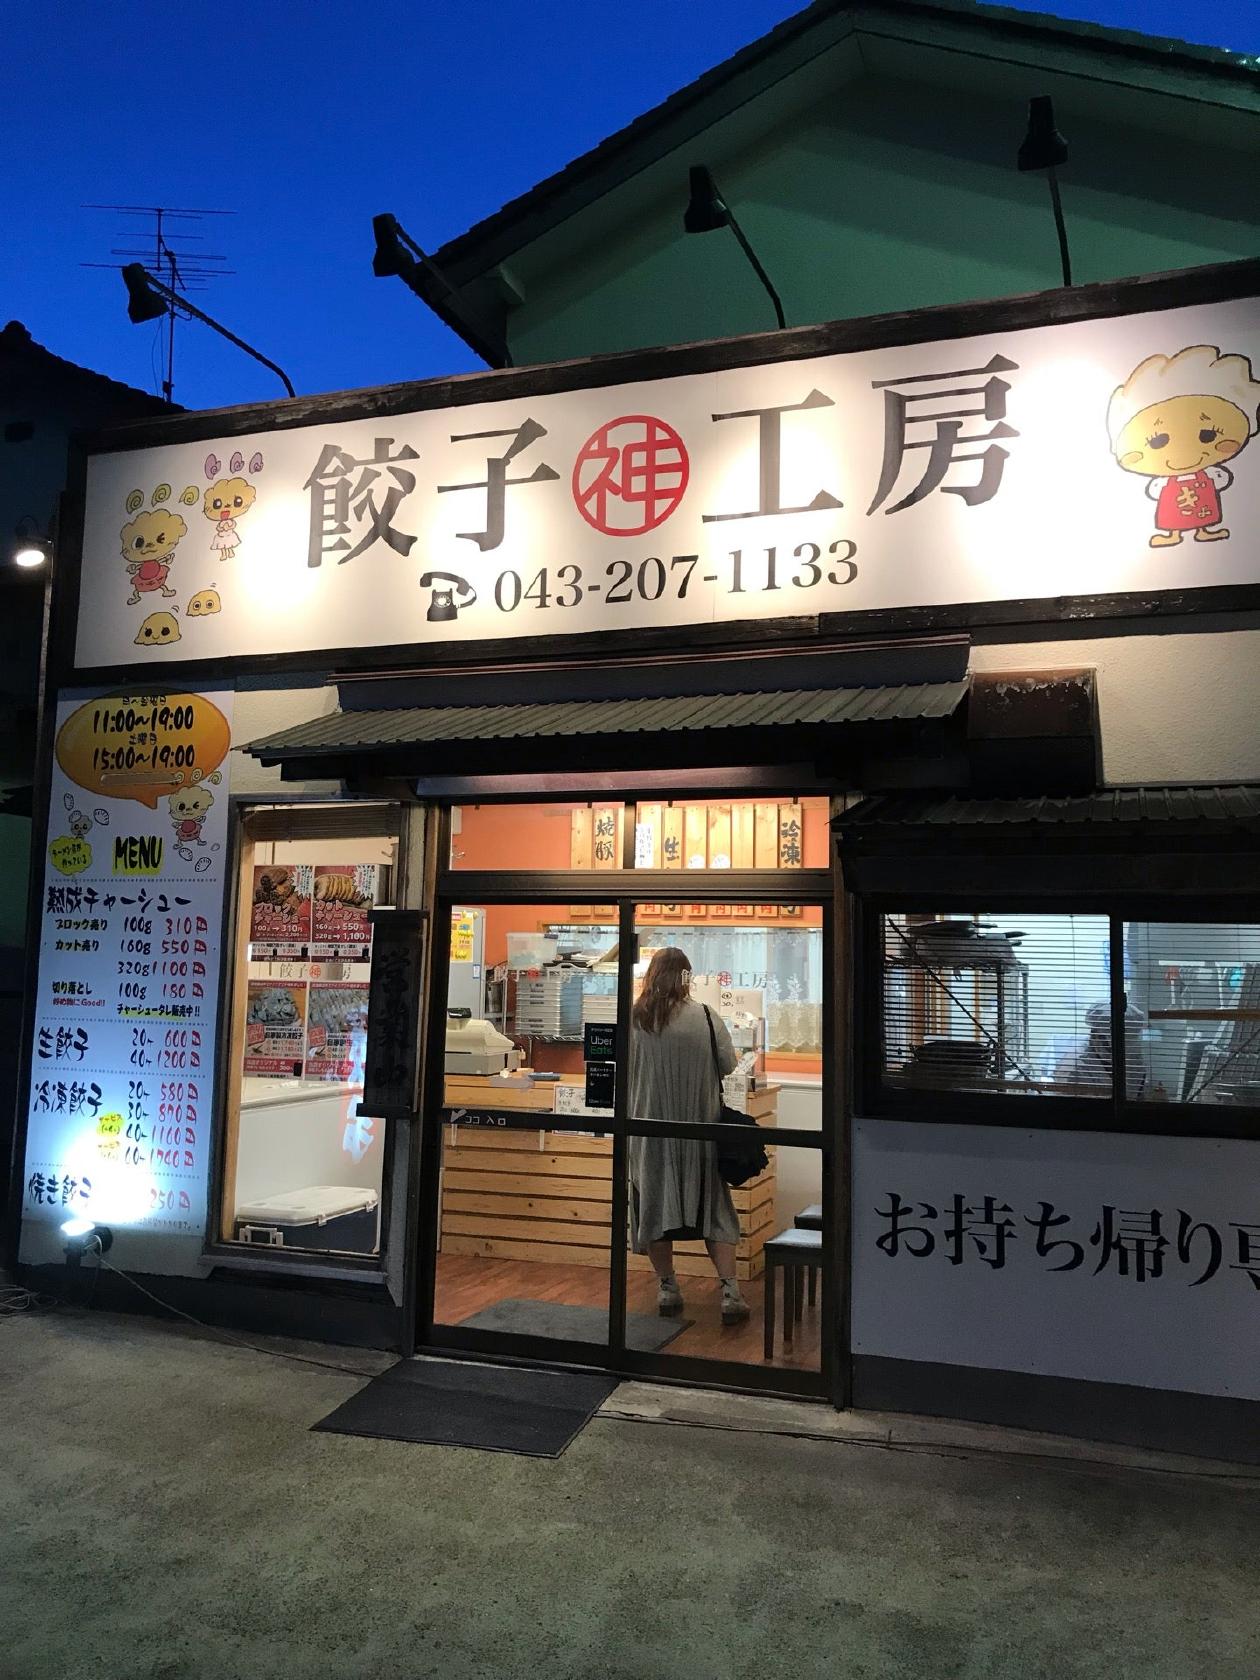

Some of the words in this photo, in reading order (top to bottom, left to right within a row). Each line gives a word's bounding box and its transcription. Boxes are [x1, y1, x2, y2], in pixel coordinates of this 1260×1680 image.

[494, 539, 859, 613] 043-207-1133
[115, 836, 163, 869] MENU
[54, 918, 108, 931] ブロック売り
[124, 916, 153, 935] 100g
[55, 939, 100, 952] カット売り
[120, 939, 152, 956] 160g
[117, 961, 150, 977] 320g
[52, 981, 93, 995] 切り落とし
[118, 983, 148, 1000] 100g
[590, 1036, 613, 1046] Uber
[590, 1046, 613, 1055] Eats
